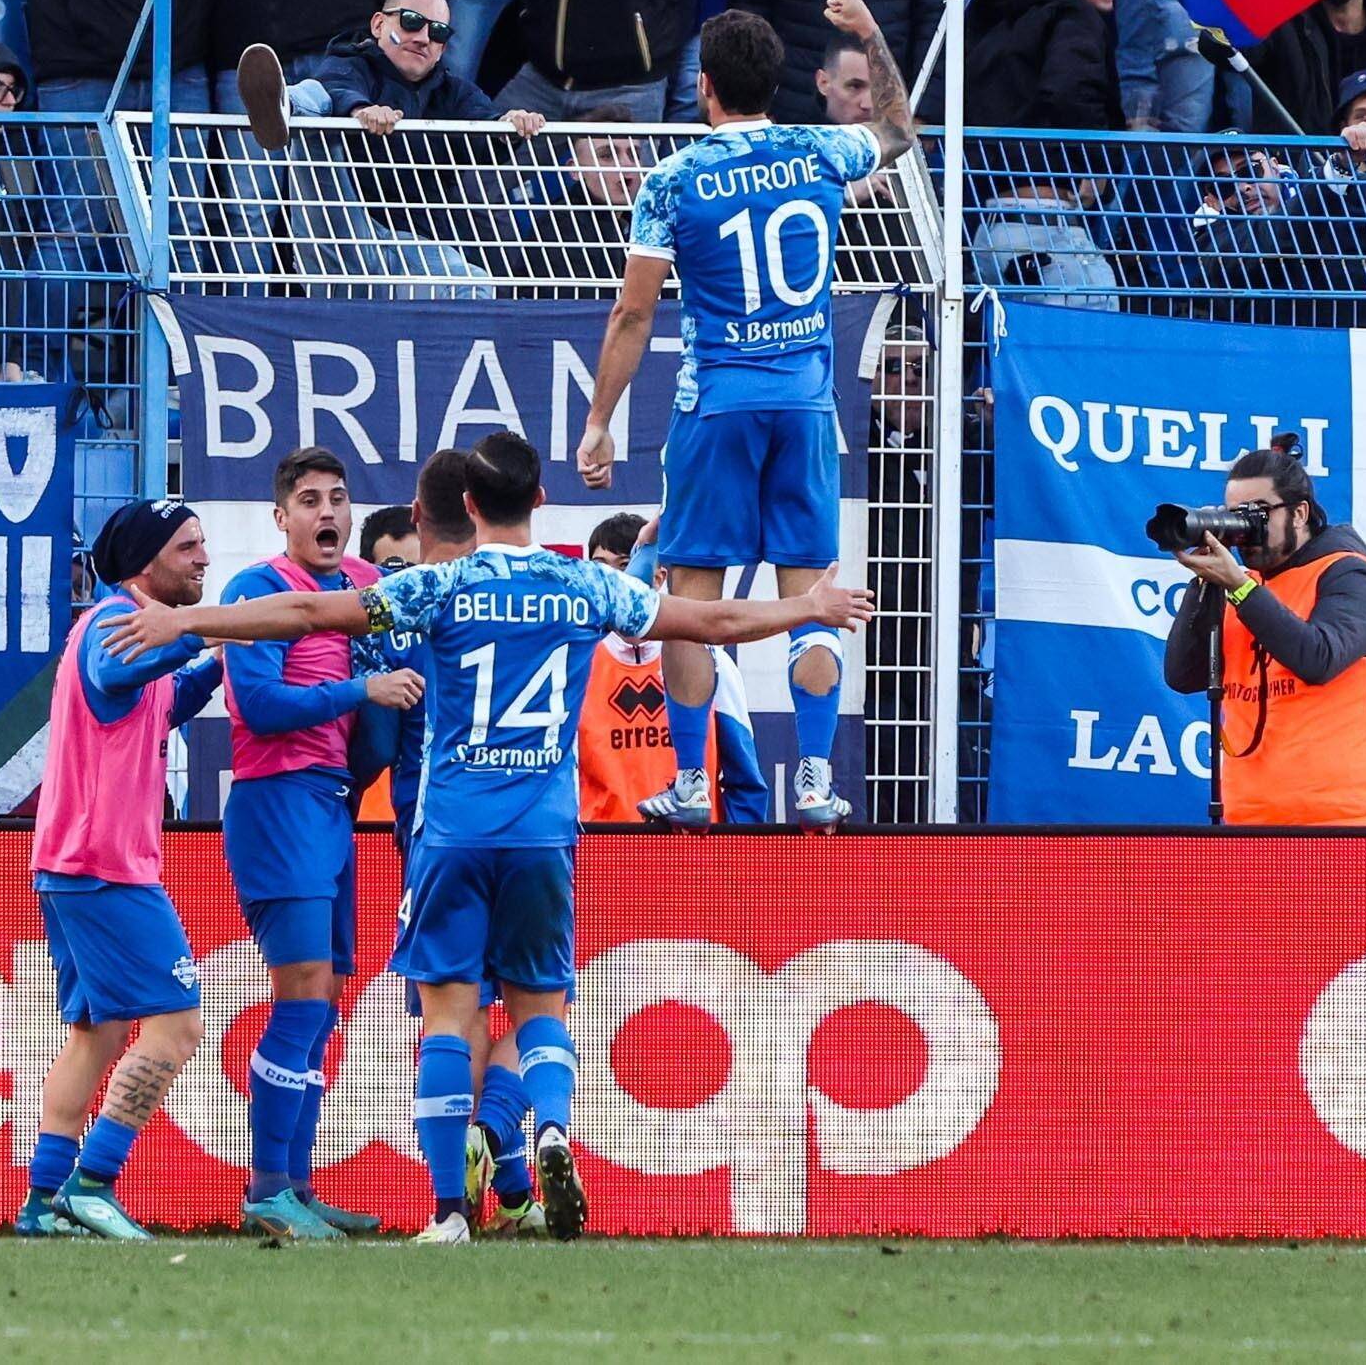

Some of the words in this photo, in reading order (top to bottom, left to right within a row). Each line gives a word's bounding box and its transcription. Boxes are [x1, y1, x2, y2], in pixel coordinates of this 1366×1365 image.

[696, 153, 822, 201] CUTRONE
[719, 199, 829, 316] 10
[194, 334, 851, 465] BRIAN
[1028, 395, 1330, 478] QUELLI
[453, 592, 590, 625] BELLEMO
[460, 642, 570, 748] 14
[1067, 709, 1212, 779] LAG
